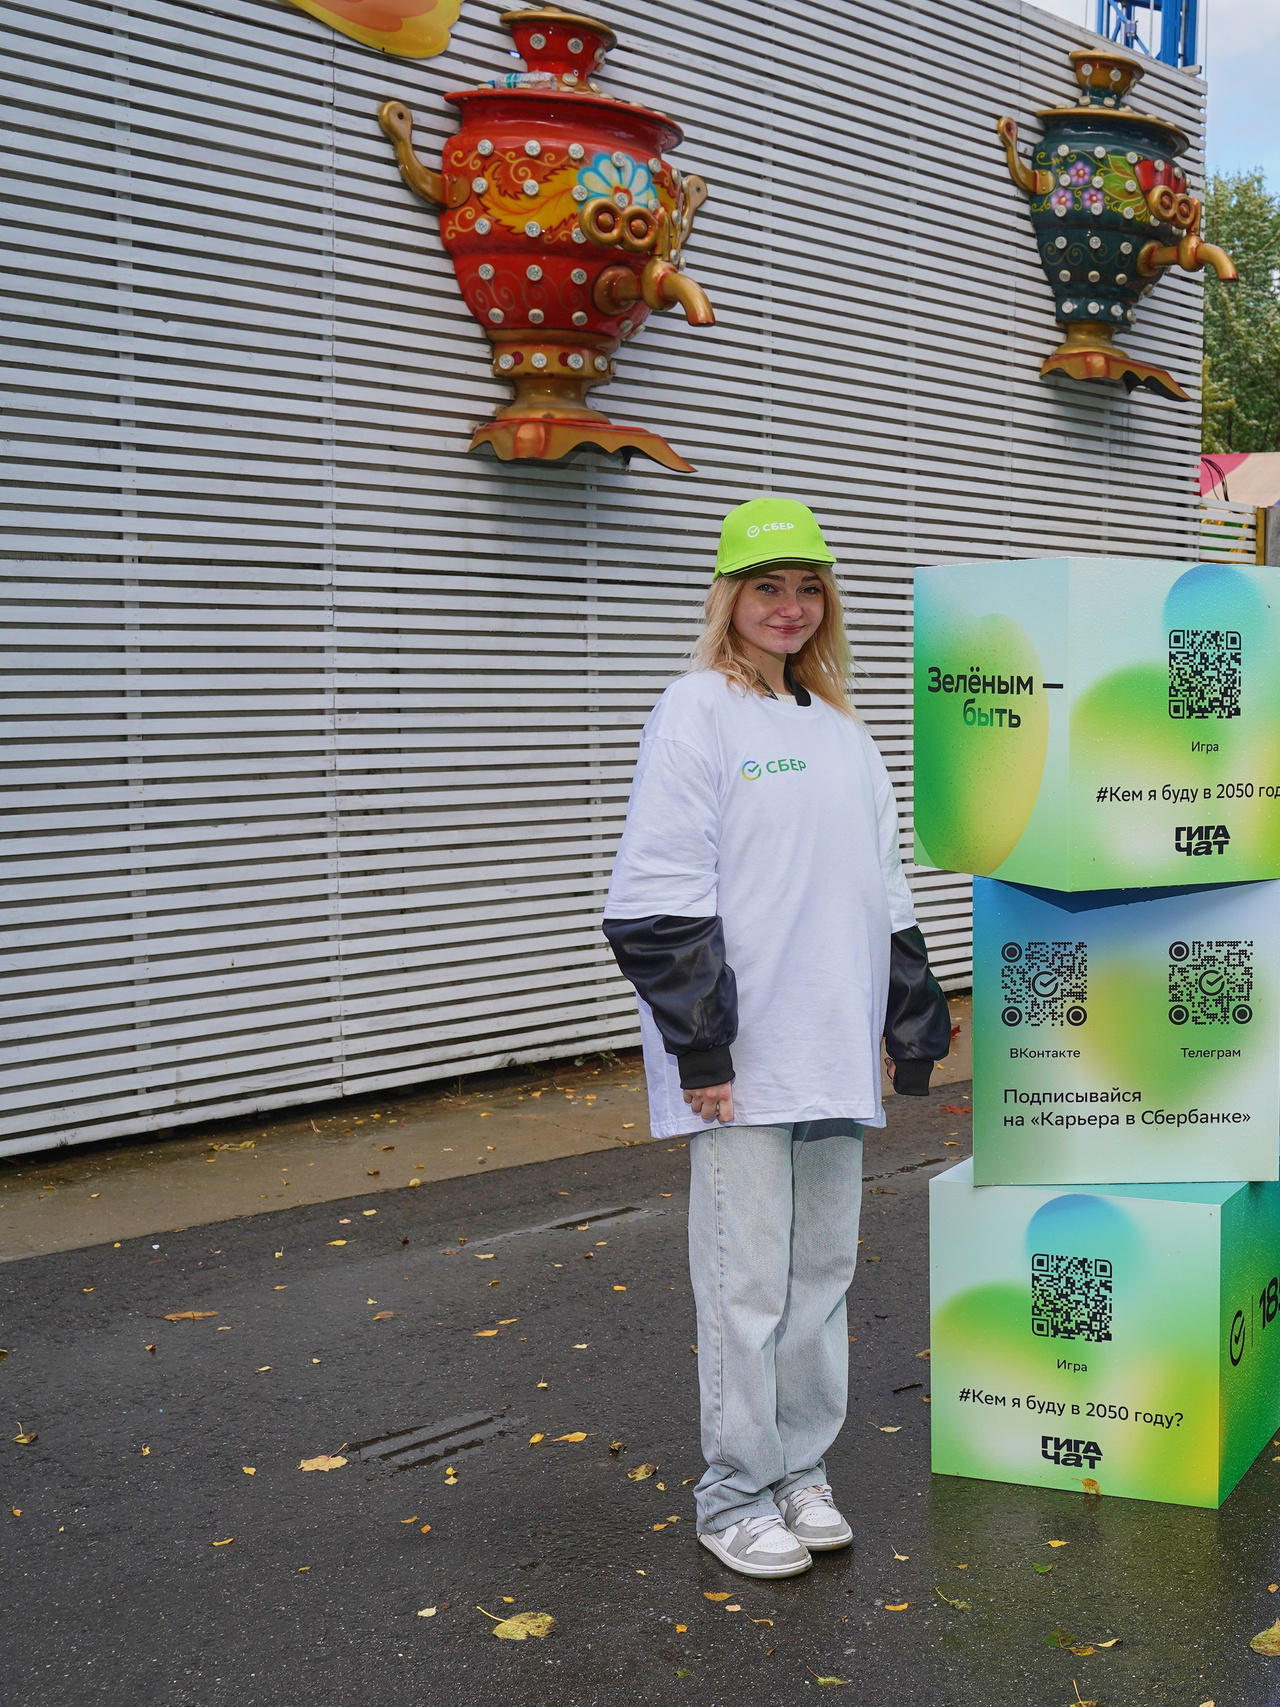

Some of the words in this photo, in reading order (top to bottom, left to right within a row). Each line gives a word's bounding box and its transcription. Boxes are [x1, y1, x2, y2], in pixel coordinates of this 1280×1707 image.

[763, 522, 794, 532] СБЕР
[927, 666, 1034, 695] Зелёным
[962, 698, 1021, 728] быть
[1191, 741, 1219, 754] Игра
[766, 758, 807, 774] СБЕР
[1096, 785, 1143, 803] #Кем
[1147, 789, 1157, 801] я
[1161, 784, 1198, 804] буду
[1203, 787, 1212, 800] в
[1216, 782, 1254, 800] 2050
[1175, 825, 1231, 841] ГИГА
[1010, 1047, 1081, 1059] ВКонтакте
[1181, 1047, 1241, 1060] Телеграм
[1003, 1086, 1142, 1106] Подписывайся
[1003, 1113, 1025, 1126] на
[1031, 1110, 1120, 1129] «Карьера
[1126, 1113, 1136, 1125] в
[1141, 1108, 1251, 1128] Сбербанке»
[1057, 1358, 1088, 1373] Игра
[958, 1388, 1006, 1407] #Кем
[1011, 1397, 1021, 1408] я
[1026, 1395, 1066, 1416] буду
[1071, 1404, 1080, 1415] в
[1085, 1402, 1129, 1421] 2050
[1134, 1409, 1184, 1429] году?
[1041, 1435, 1104, 1456] ГИГА
